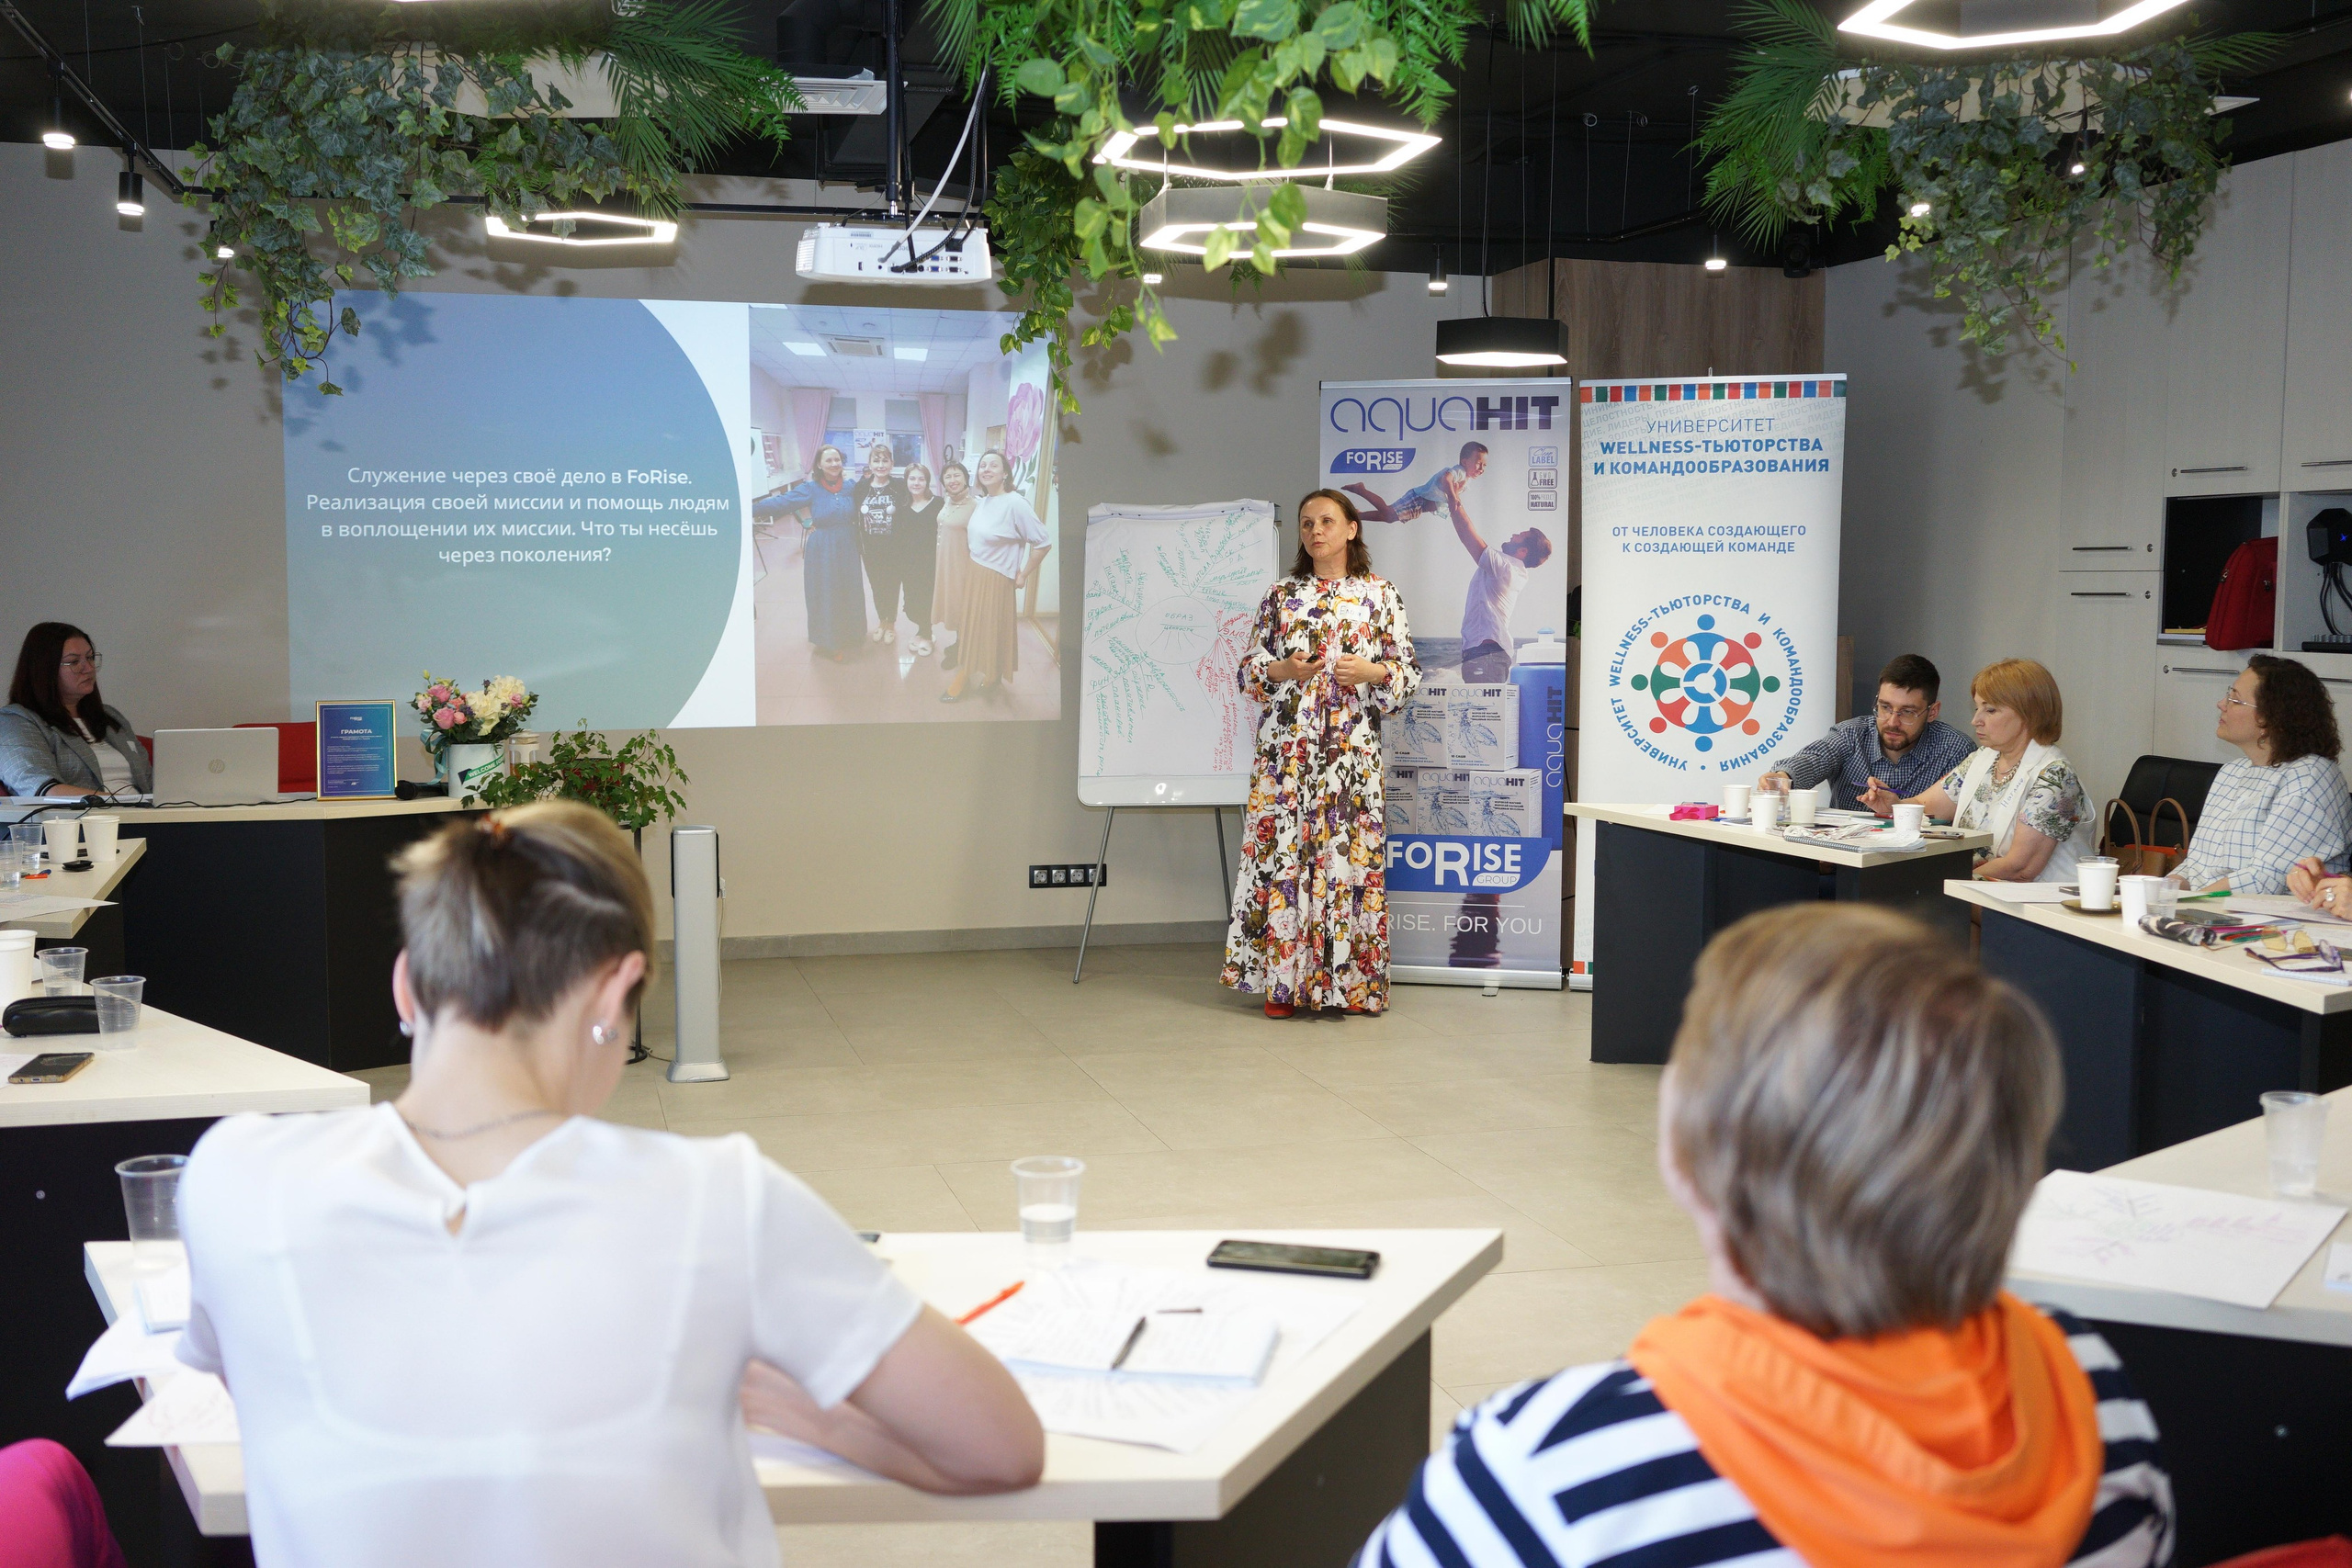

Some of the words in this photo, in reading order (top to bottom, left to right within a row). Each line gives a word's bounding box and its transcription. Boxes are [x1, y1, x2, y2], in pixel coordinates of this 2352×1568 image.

[1330, 396, 1559, 441] aquaHIT
[1647, 418, 1775, 434] УНИВЕРСИТЕТ
[1600, 438, 1824, 455] WELLNESS-ТЬЮТОРСТВА
[1347, 451, 1404, 470] FORISE
[1594, 462, 1605, 475] И
[1611, 458, 1829, 476] КОМАНДООБРАЗОВАНИЯ
[347, 467, 447, 488] Служение
[452, 469, 508, 489] через
[513, 466, 556, 486] своё
[561, 469, 606, 488] дело
[611, 470, 621, 485] в
[627, 468, 693, 486] FoRise.
[307, 494, 425, 513] Реализация
[432, 494, 488, 511] своей
[494, 496, 564, 511] миссии
[569, 496, 581, 511] и
[587, 496, 663, 513] помощь
[669, 495, 729, 513] людям
[322, 524, 333, 537] в
[338, 522, 469, 539] воплощении
[474, 523, 496, 536] их
[502, 523, 576, 536] миссии.
[581, 521, 615, 537] Что
[620, 523, 643, 536] ты
[649, 519, 718, 536] несёшь
[1612, 526, 1628, 536] ОТ
[1633, 525, 1704, 536] ЧЕЛОВЕКА
[1708, 525, 1806, 537] СОЗДАЮЩЕГО
[438, 547, 495, 566] через
[501, 546, 611, 564] поколения?
[1623, 542, 1631, 553] К
[1634, 539, 1724, 555] СОЗДАЮЩЕЙ
[1728, 540, 1795, 554] КОМАНДЕ
[1758, 613, 1771, 626] И
[1609, 593, 1751, 687] WELLNESS-ТЬЮТОРСТВА
[1452, 689, 1502, 699] aquaHIT
[1718, 627, 1808, 773] КОМАНДООБРАЗОВАНИЯ
[1546, 686, 1563, 788] aquaHIT
[1611, 697, 1689, 772] УНИВЕРСИТЕТ
[468, 762, 495, 778] WELCOME
[1474, 775, 1525, 787] aquaHIT
[1387, 840, 1521, 886] FORISE
[1476, 874, 1518, 885] GROUP
[1443, 915, 1488, 934] FOR
[1496, 917, 1543, 935] YOU
